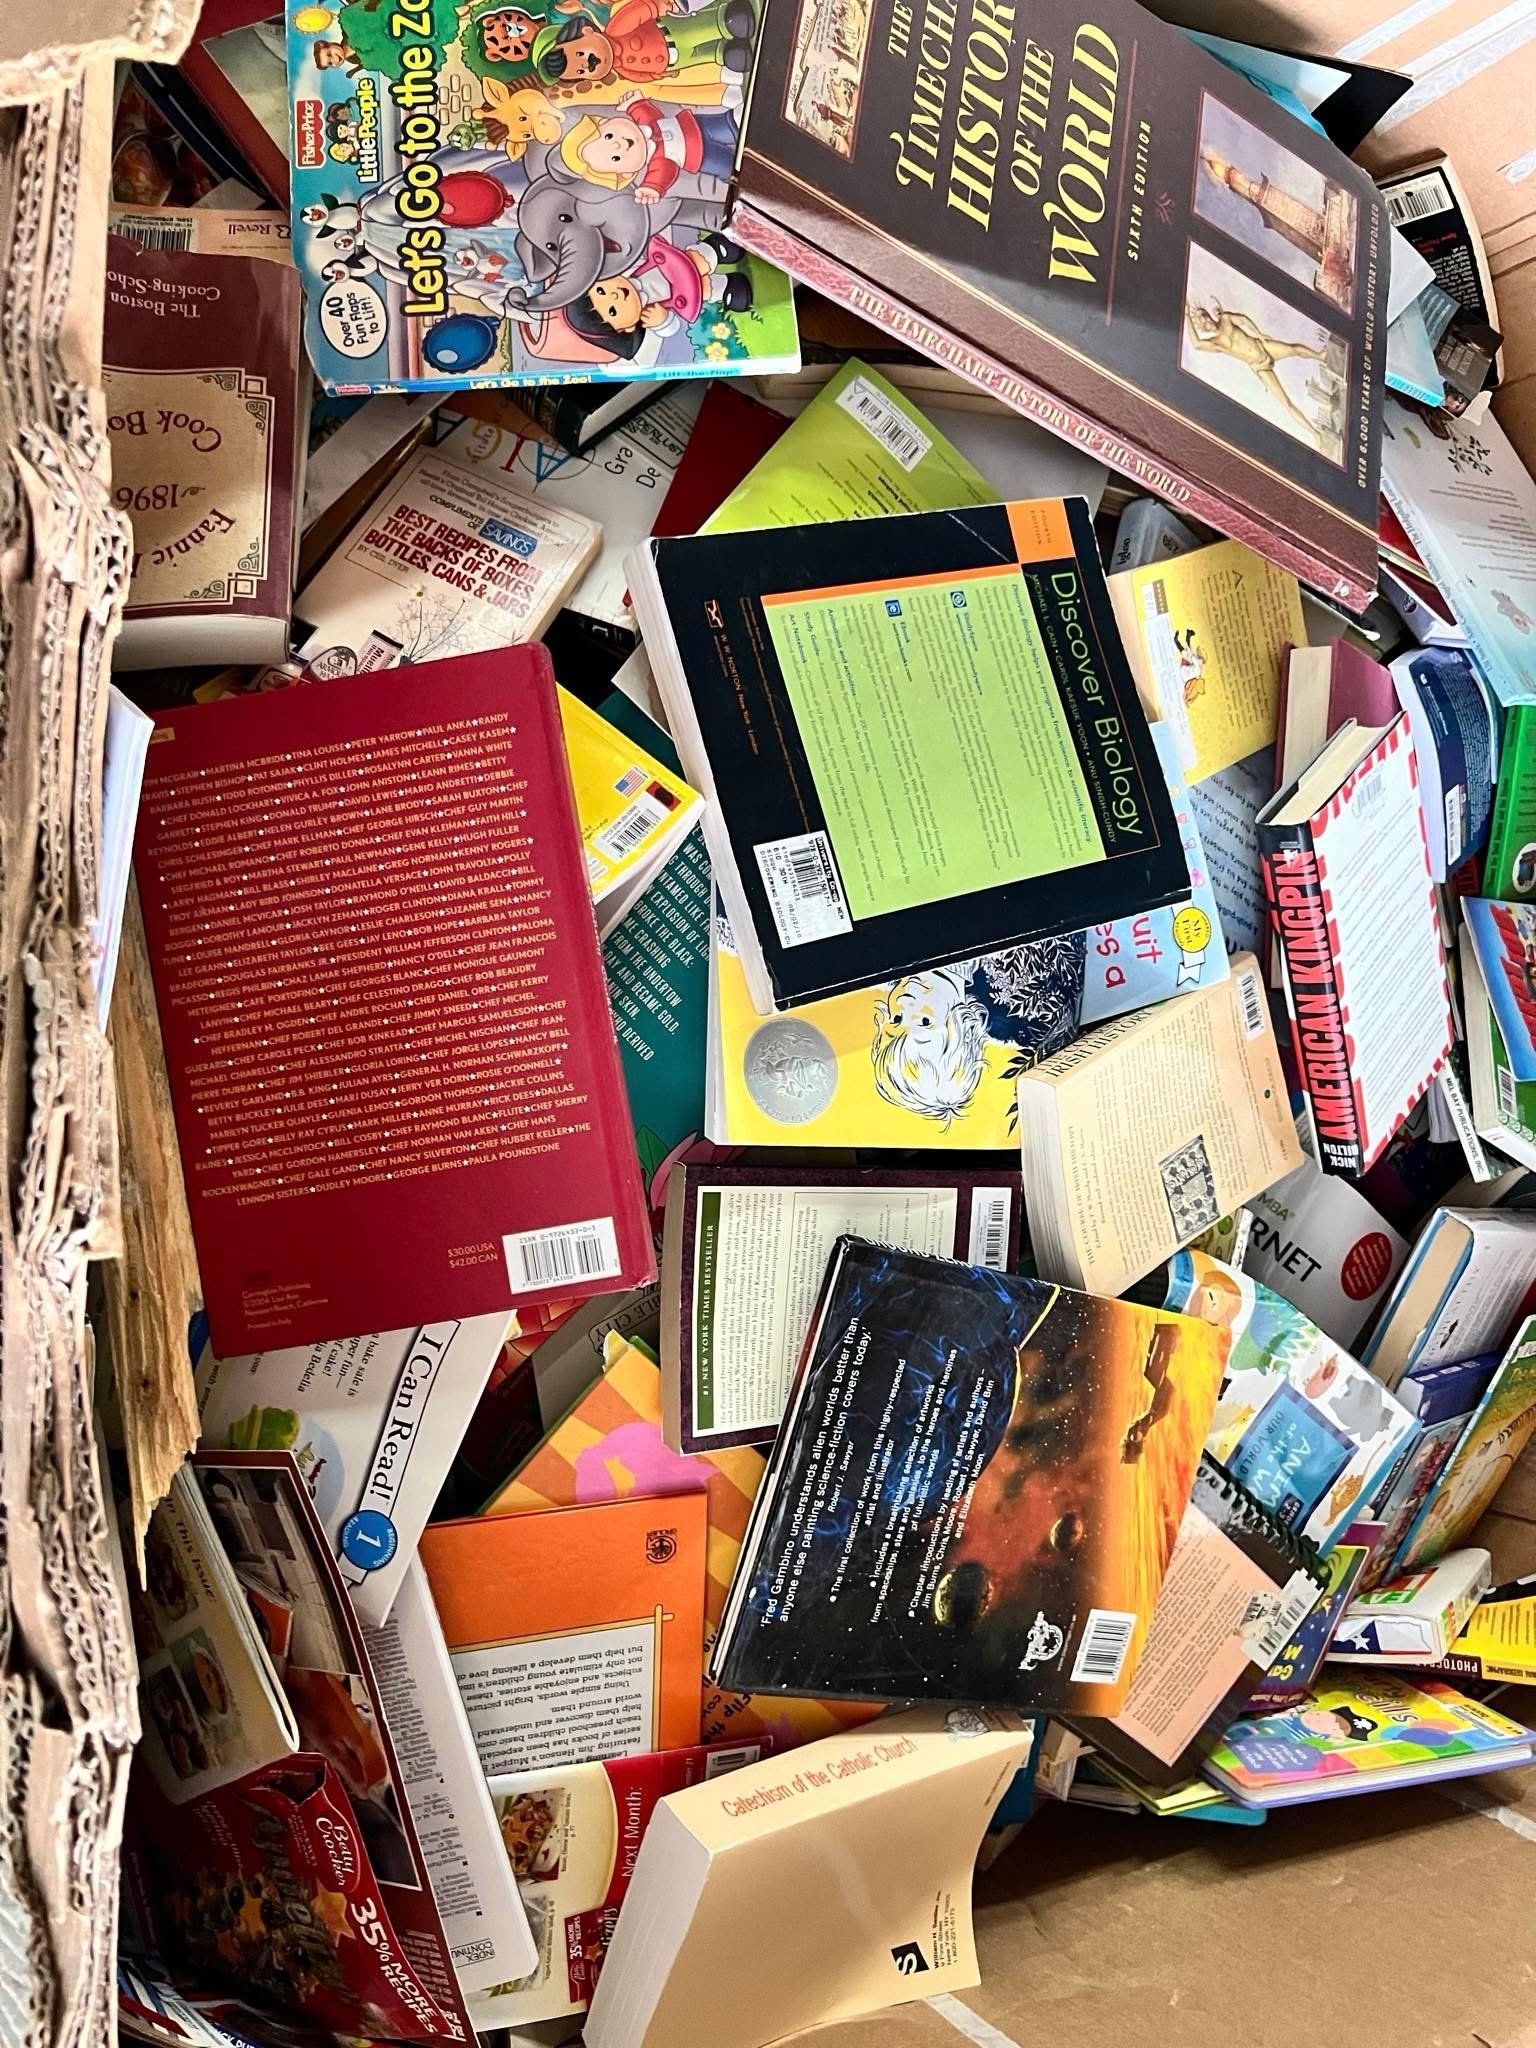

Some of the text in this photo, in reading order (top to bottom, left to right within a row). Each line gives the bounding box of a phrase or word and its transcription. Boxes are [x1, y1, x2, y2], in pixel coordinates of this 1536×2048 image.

[888, 0, 914, 58] THE
[357, 78, 379, 182] Little People
[1010, 38, 1055, 196] OF THE
[1042, 23, 1119, 283] WORLD
[392, 46, 446, 315] Let's Go to the
[1128, 121, 1152, 260] SIXTH EDITION
[228, 223, 270, 235] Revell
[110, 291, 201, 318] The Boston
[326, 297, 356, 347] Over 40
[347, 292, 369, 344] Fun Flaps
[361, 296, 381, 333] to Lift!
[1358, 204, 1380, 488] OVER YEARS OF WORLD HISTORY UNFOLDED
[850, 284, 1191, 503] THE TIMECHART HISTORY OF THE WORLD
[156, 410, 222, 453] Cook
[116, 483, 179, 512] 1896
[430, 494, 485, 525] COMPLIMENTS
[152, 508, 236, 568] Fannie
[381, 517, 484, 576] THE BACKS OF
[394, 504, 544, 584] BEST RECIPES FROM
[482, 522, 535, 555] SAVINGS
[1116, 537, 1132, 566] igloo
[364, 529, 531, 619] BOTTLES, CANS & JARS
[1045, 625, 1059, 648] CAIN
[1055, 655, 1069, 685] CAROL
[1077, 722, 1089, 750] YOON
[1086, 759, 1099, 779] ANU
[1051, 572, 1143, 835] Discover Biology
[351, 712, 509, 749] PETER YARROW PAUL ANKA RANDY
[683, 843, 698, 863] WAS
[675, 862, 708, 898] THROUGH
[633, 900, 661, 929] BROKE
[656, 923, 673, 942] THE
[650, 892, 698, 944] EXPLOSION OF
[684, 897, 704, 922] LIKE
[610, 931, 683, 1008] FROM THE UNDERTOW
[634, 930, 672, 969] CRASHING
[617, 966, 635, 985] AND
[631, 981, 662, 1014] BECAME
[618, 995, 641, 1021] SKIN.
[1274, 851, 1356, 1141] AMERICAN KINGPIN
[621, 1027, 655, 1061] DERIVED
[1045, 1009, 1153, 1078] IRISH HISTORY
[495, 1070, 565, 1091] JACKIE COLLINS
[393, 1141, 561, 1180] GEORGE BURNS PAULA POUNDSTONE
[1322, 1142, 1359, 1156] BILTON
[1329, 1155, 1357, 1168] NICK
[447, 1241, 495, 1259] $30.00 USA
[449, 1252, 498, 1269] $42.00 CAN
[705, 1223, 714, 1293] BESTSELLER
[704, 1294, 712, 1328] TIMES
[703, 1329, 711, 1356] YORK
[297, 1355, 323, 1393] Bedelia
[371, 1332, 444, 1503] I Can Read!
[771, 1537, 791, 1598] Gambino
[789, 1460, 817, 1537] understands
[813, 1427, 826, 1460] alien
[822, 1383, 837, 1428] worlds
[833, 1340, 849, 1381] better
[847, 1316, 860, 1344] than
[827, 1439, 855, 1514] Robert Sawyer
[779, 1573, 797, 1623] anyone
[795, 1545, 808, 1574] else
[804, 1494, 822, 1548] painting
[818, 1408, 848, 1510] science-fiction
[843, 1368, 858, 1409] covers
[355, 1525, 382, 1549] 1
[538, 1645, 643, 1668] but help them develop
[477, 1711, 594, 1739] discover understand
[721, 1735, 919, 1818] Catechism of the Catholic Church
[315, 1816, 346, 1887] Crocker
[332, 1825, 355, 1874] Betty
[621, 1785, 643, 1879] Next Month:
[350, 1897, 394, 1963] 35%
[464, 1948, 495, 1963] INDEX
[379, 1964, 438, 2033] RECIPES
[390, 1961, 436, 2018] MORE
